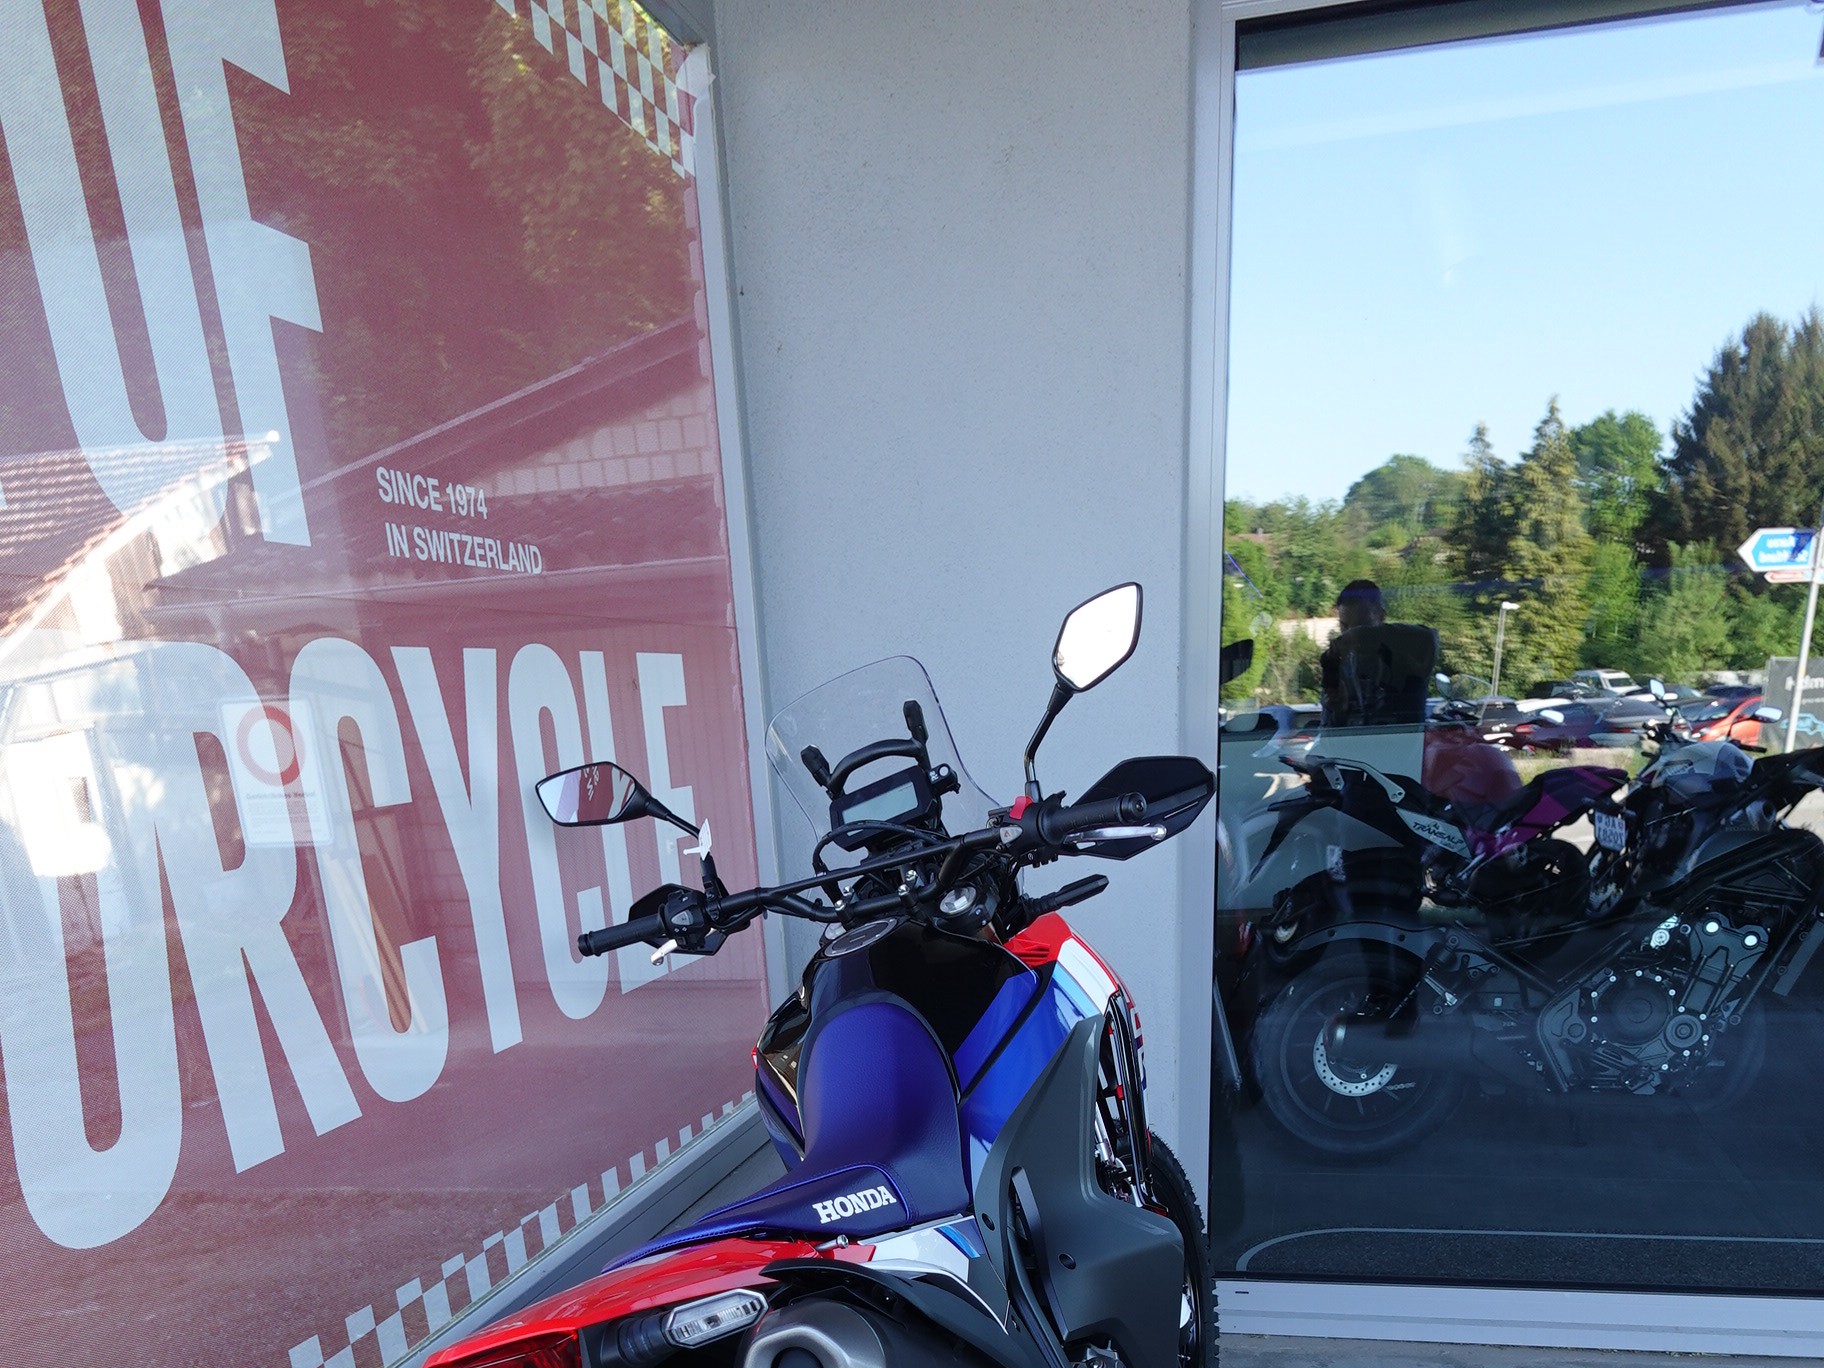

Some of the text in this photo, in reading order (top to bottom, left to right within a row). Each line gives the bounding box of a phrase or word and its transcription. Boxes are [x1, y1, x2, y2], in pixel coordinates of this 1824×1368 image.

[376, 466, 488, 519] SINCE 1974
[385, 522, 543, 574] IN SWITZERLAND
[1412, 822, 1464, 844] TRANSALP
[812, 1186, 897, 1224] HONDA
